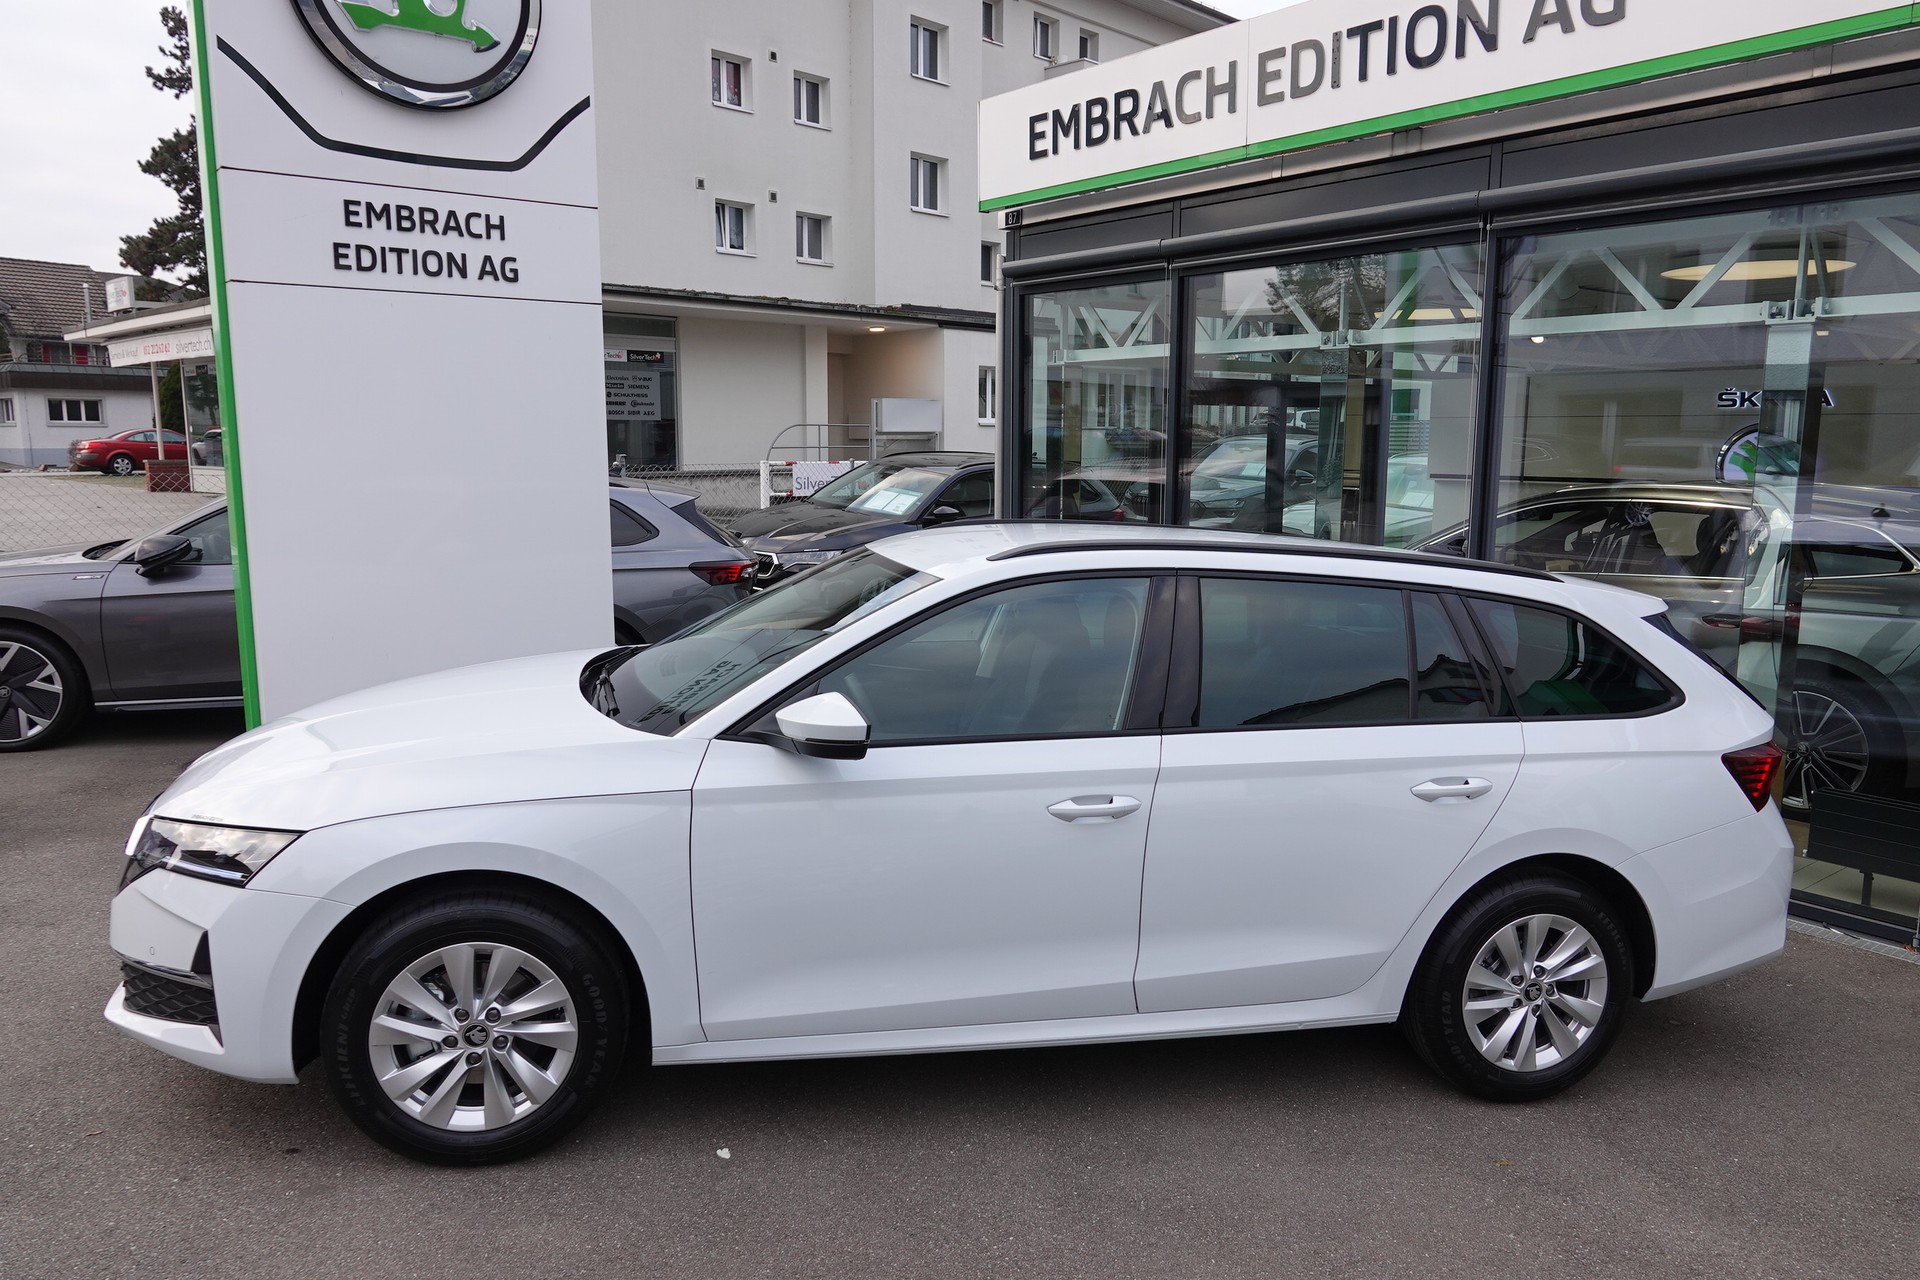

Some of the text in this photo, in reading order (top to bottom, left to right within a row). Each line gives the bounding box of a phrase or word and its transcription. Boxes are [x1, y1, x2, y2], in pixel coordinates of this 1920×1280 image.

[1028, 60, 1239, 161] EMBRACH
[1256, 0, 1500, 107] EDITION
[343, 199, 506, 241] EMBRACH
[1008, 212, 1017, 224] 87
[332, 242, 519, 282] EDITION AG
[175, 336, 212, 354] silvertech.ch
[1717, 387, 1835, 408] ŠKA
